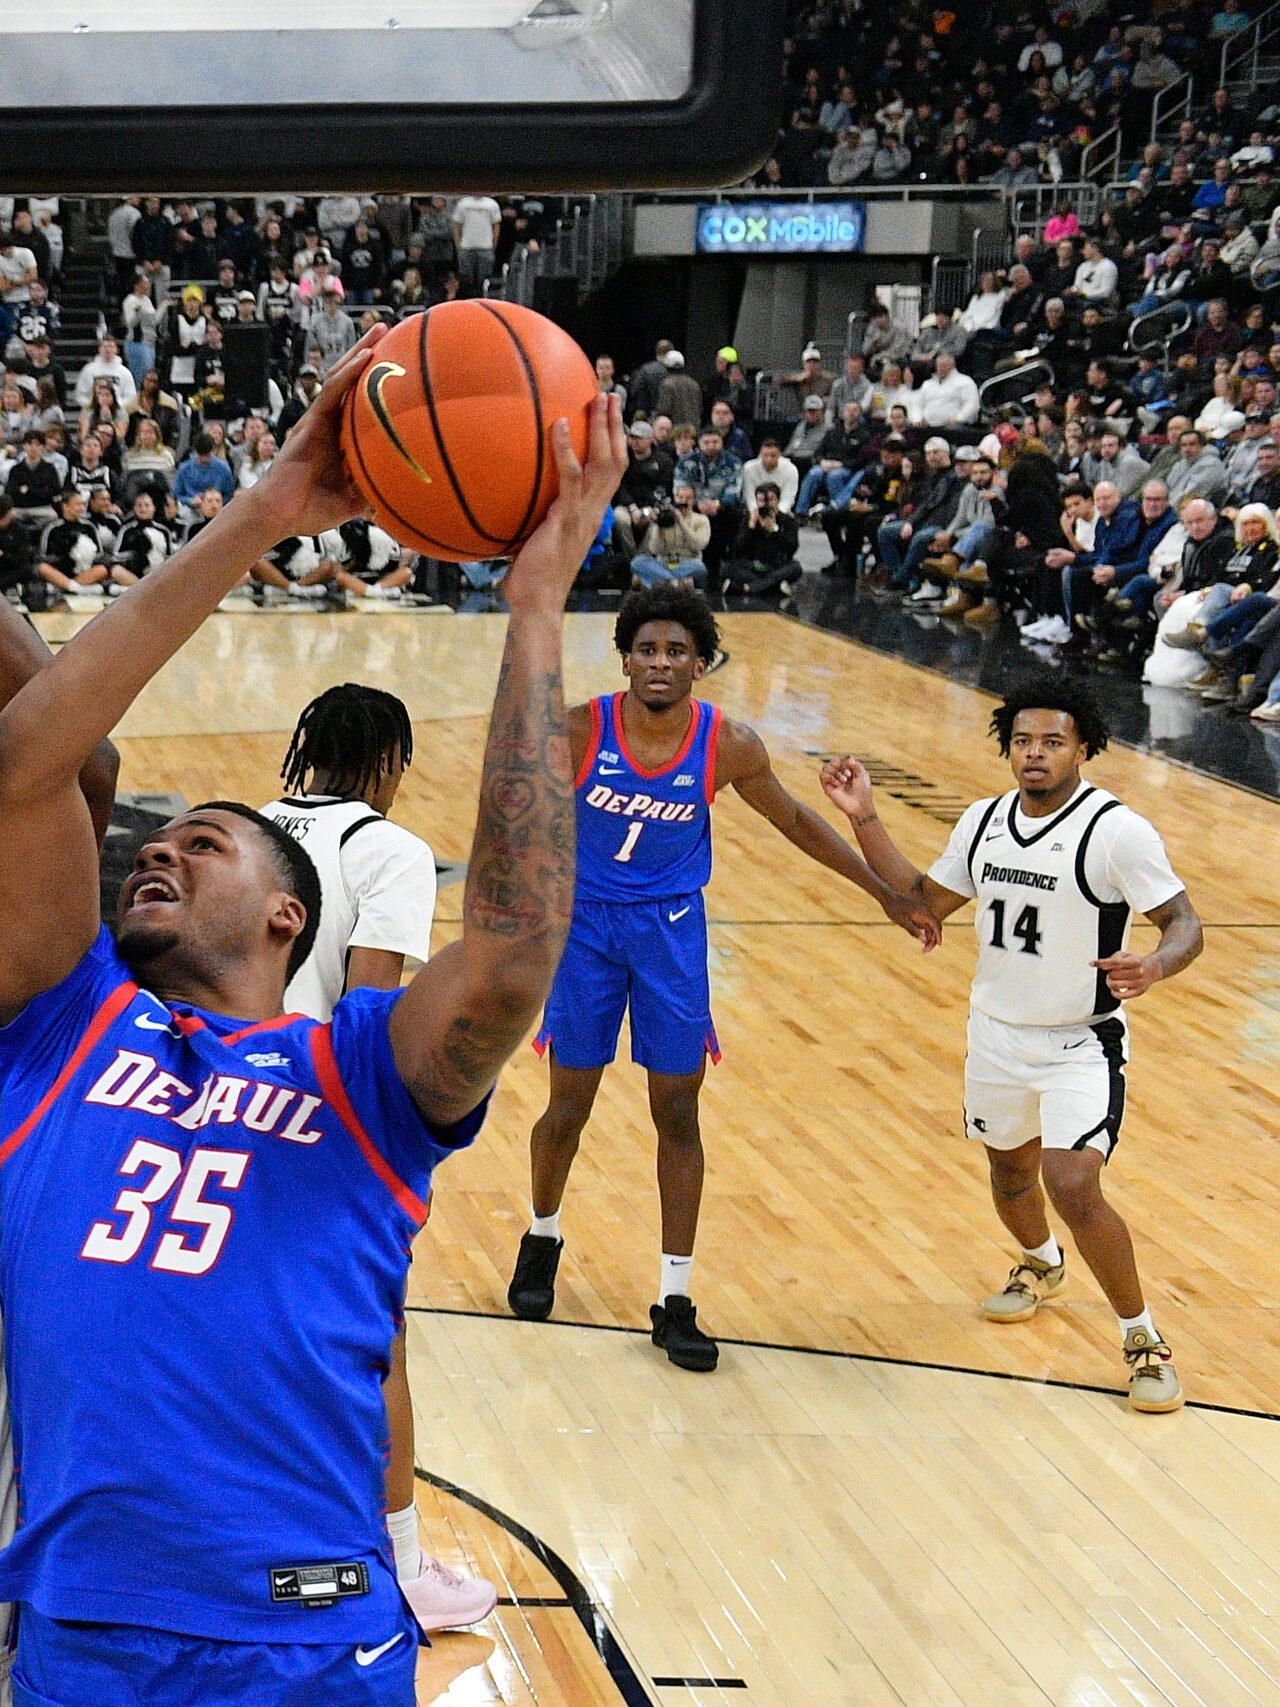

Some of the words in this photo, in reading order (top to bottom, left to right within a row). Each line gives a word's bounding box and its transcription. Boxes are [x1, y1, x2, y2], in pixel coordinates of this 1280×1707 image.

[771, 214, 855, 242] Mobile
[613, 821, 644, 863] 1
[980, 862, 1059, 892] PROVIDENCE
[986, 899, 1043, 957] 14
[79, 1138, 252, 1275] 35
[340, 1570, 358, 1586] 48
